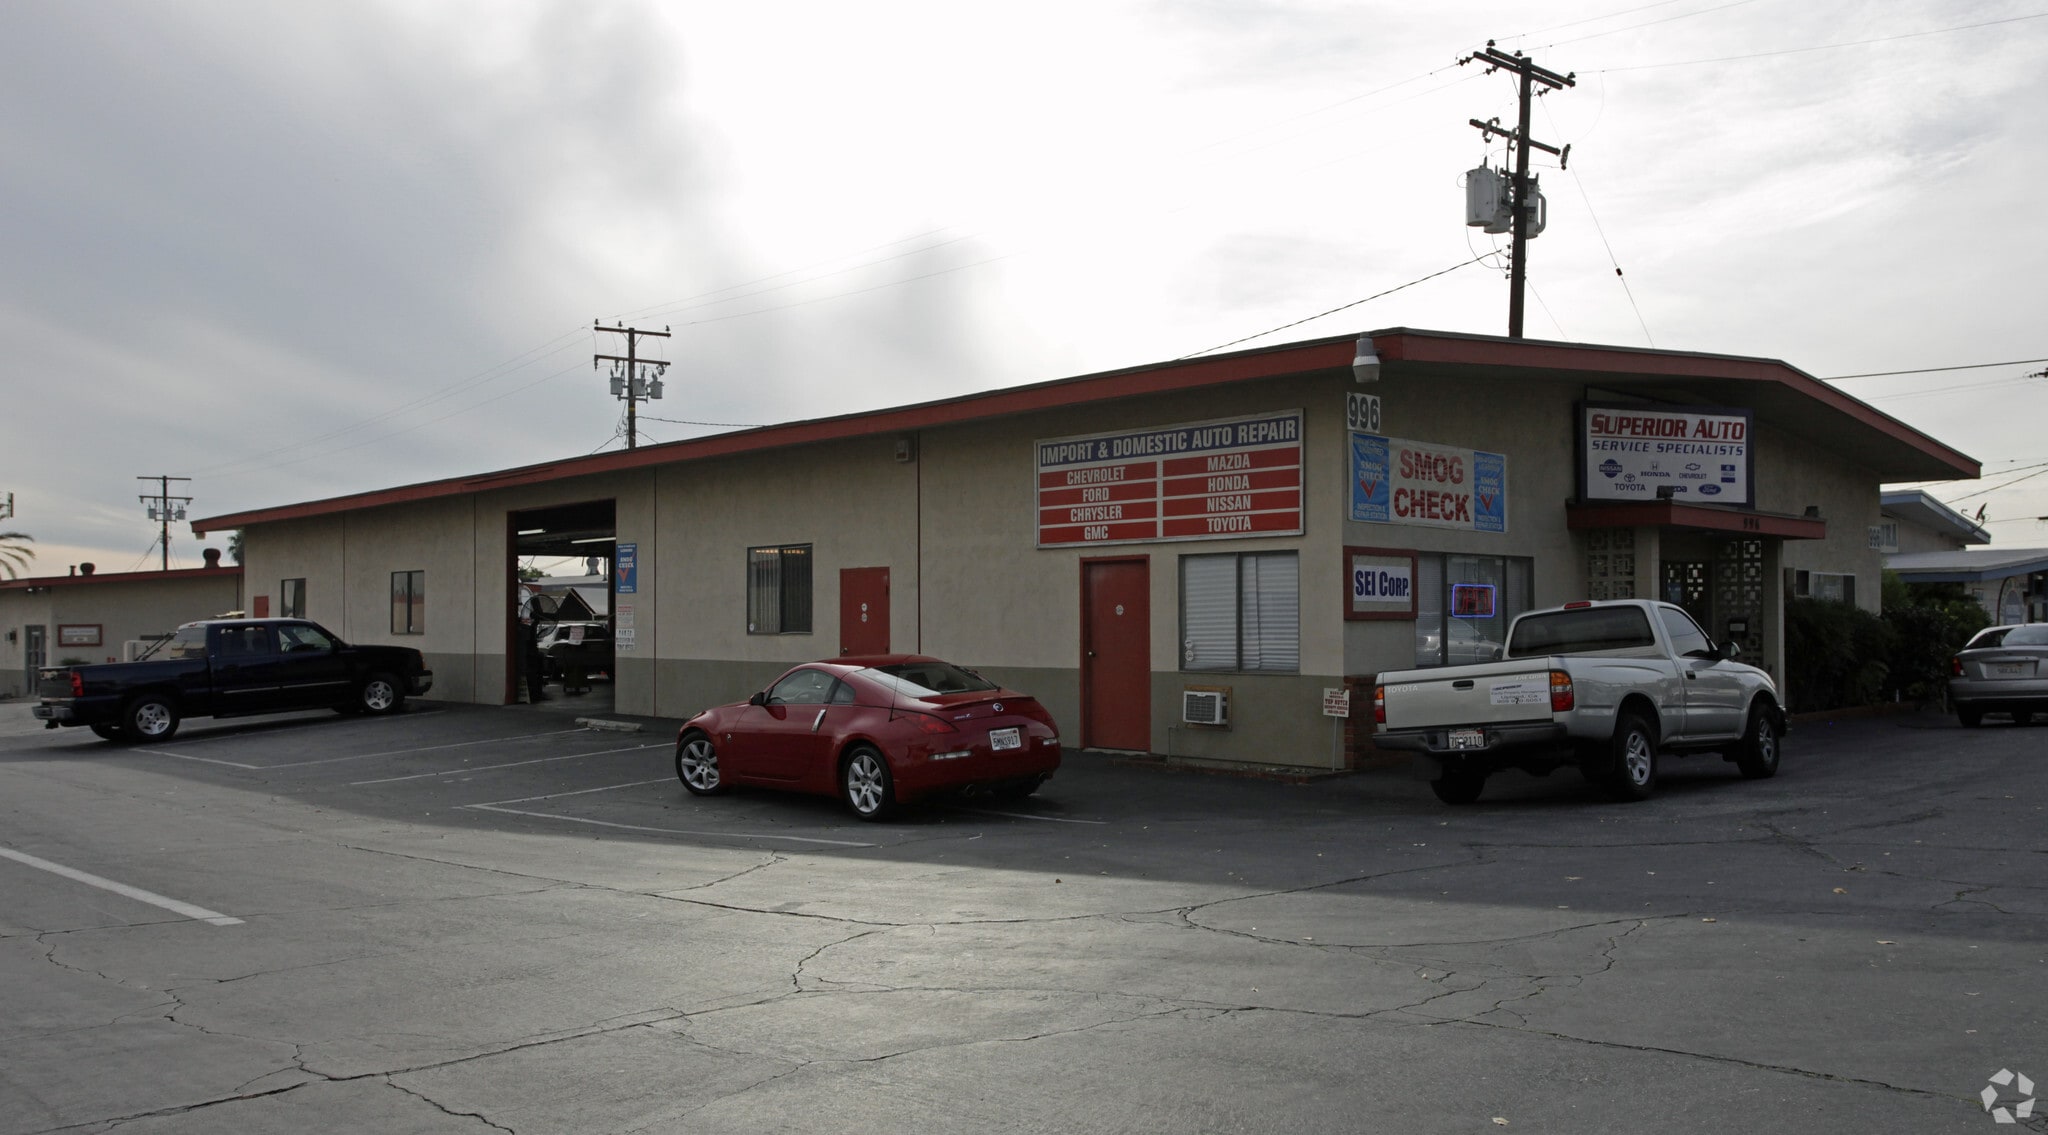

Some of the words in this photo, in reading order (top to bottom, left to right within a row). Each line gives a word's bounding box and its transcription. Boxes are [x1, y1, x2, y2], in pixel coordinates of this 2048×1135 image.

[1349, 395, 1379, 431] 996
[1591, 414, 1687, 438] SUPERIOR
[1693, 419, 1745, 440] AUTO
[1041, 442, 1094, 465] IMPORT
[1098, 442, 1109, 458] &
[1113, 431, 1187, 457] DOMESTIC
[1192, 427, 1232, 449] AUTO
[1238, 419, 1296, 444] REPAIR
[1592, 440, 1650, 453] SERVICE
[1657, 443, 1744, 456] SPECIALISTS
[1207, 454, 1251, 472] MAZDA
[1400, 449, 1464, 485] SMOG
[1067, 466, 1126, 485] CHEVROLET
[1207, 475, 1250, 493] HONDA
[1083, 487, 1110, 502] FORD
[1614, 483, 1646, 492] TOYOTA
[1207, 495, 1251, 513] NISSAN
[1394, 487, 1471, 523] CHECK
[1070, 505, 1122, 522] CHRYSLER
[1207, 515, 1252, 533] TOYOTA
[1744, 518, 1760, 530] 996
[1084, 526, 1109, 541] GMC
[1355, 570, 1376, 596] SEI
[1379, 571, 1409, 597] CORP.
[1387, 685, 1418, 694] TOYOTA
